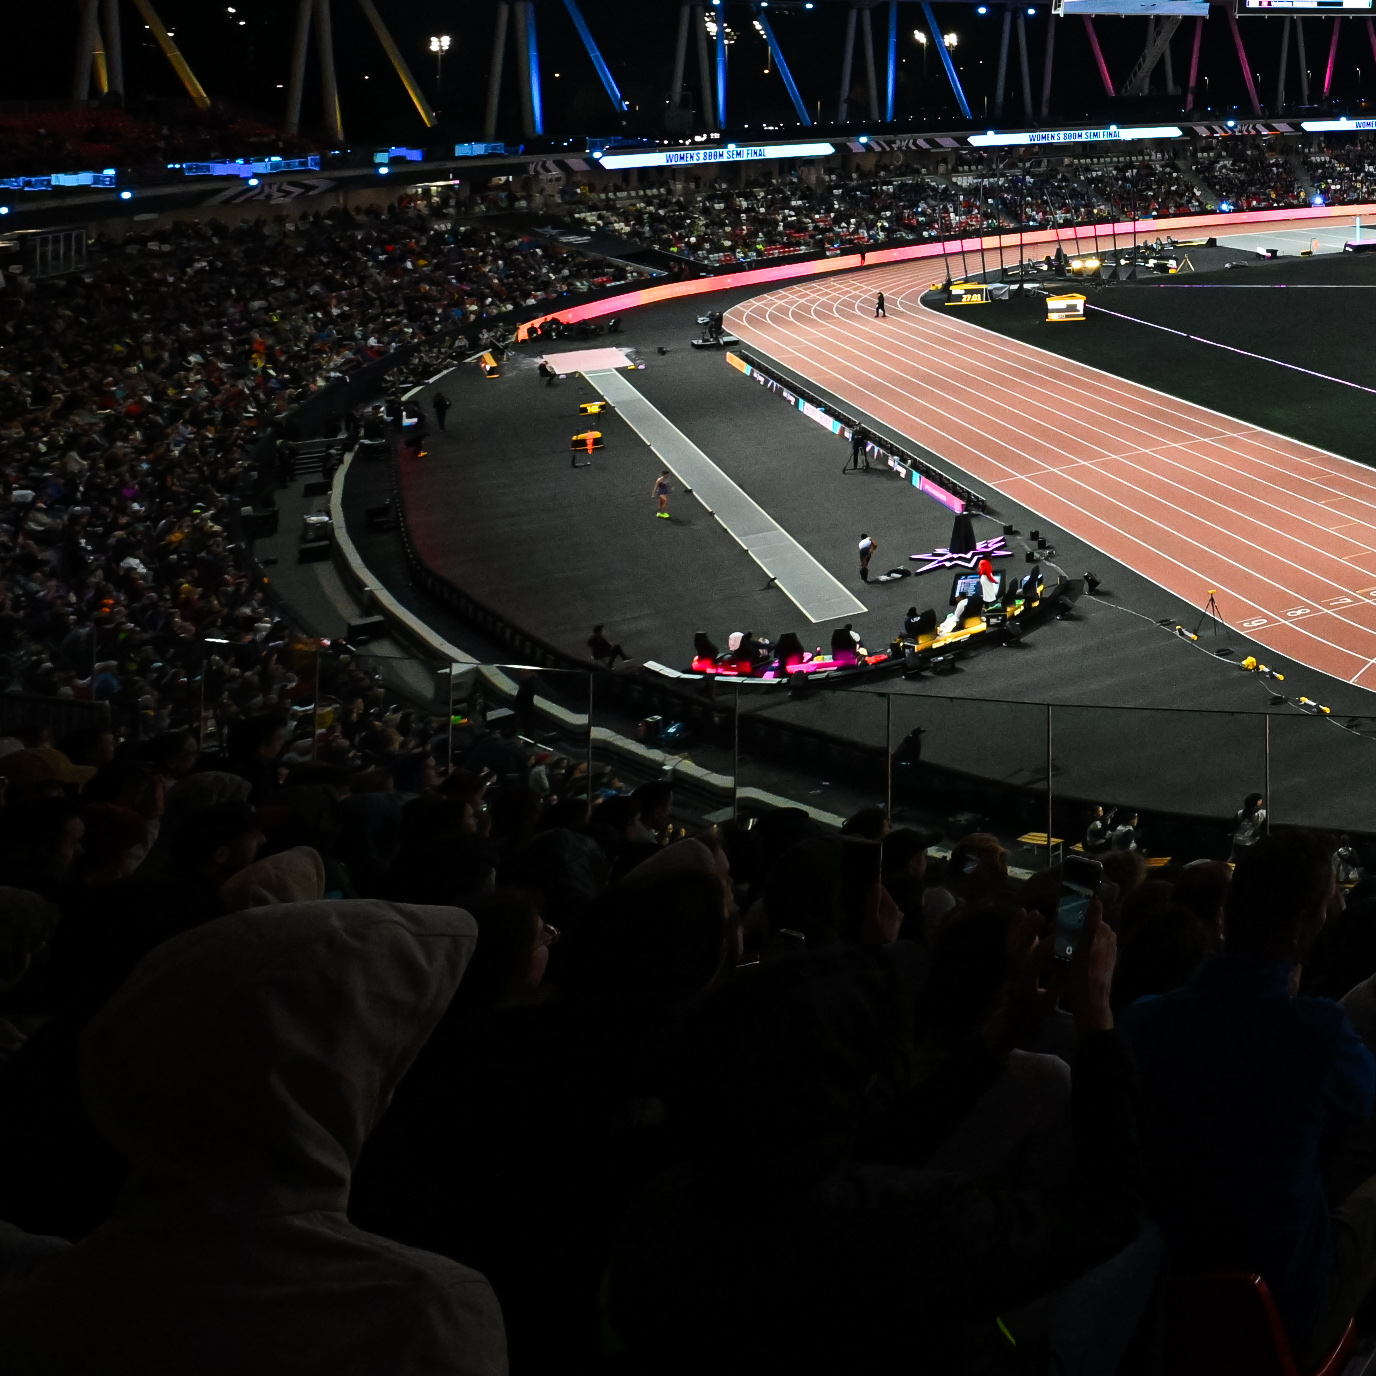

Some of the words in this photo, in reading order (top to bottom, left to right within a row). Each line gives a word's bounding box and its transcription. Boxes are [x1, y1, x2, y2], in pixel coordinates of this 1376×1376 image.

[1028, 132, 1061, 142] WOMEN'S
[1084, 131, 1101, 140] SEMI
[1102, 130, 1121, 139] FINAL
[666, 151, 701, 164] WOMEN'S
[702, 150, 724, 161] 800M
[726, 149, 744, 160] SEMI
[746, 148, 766, 159] FINAL
[962, 294, 982, 302] 27.01
[1330, 596, 1352, 606] 7
[1286, 606, 1310, 617] 8
[1244, 618, 1268, 628] 9
